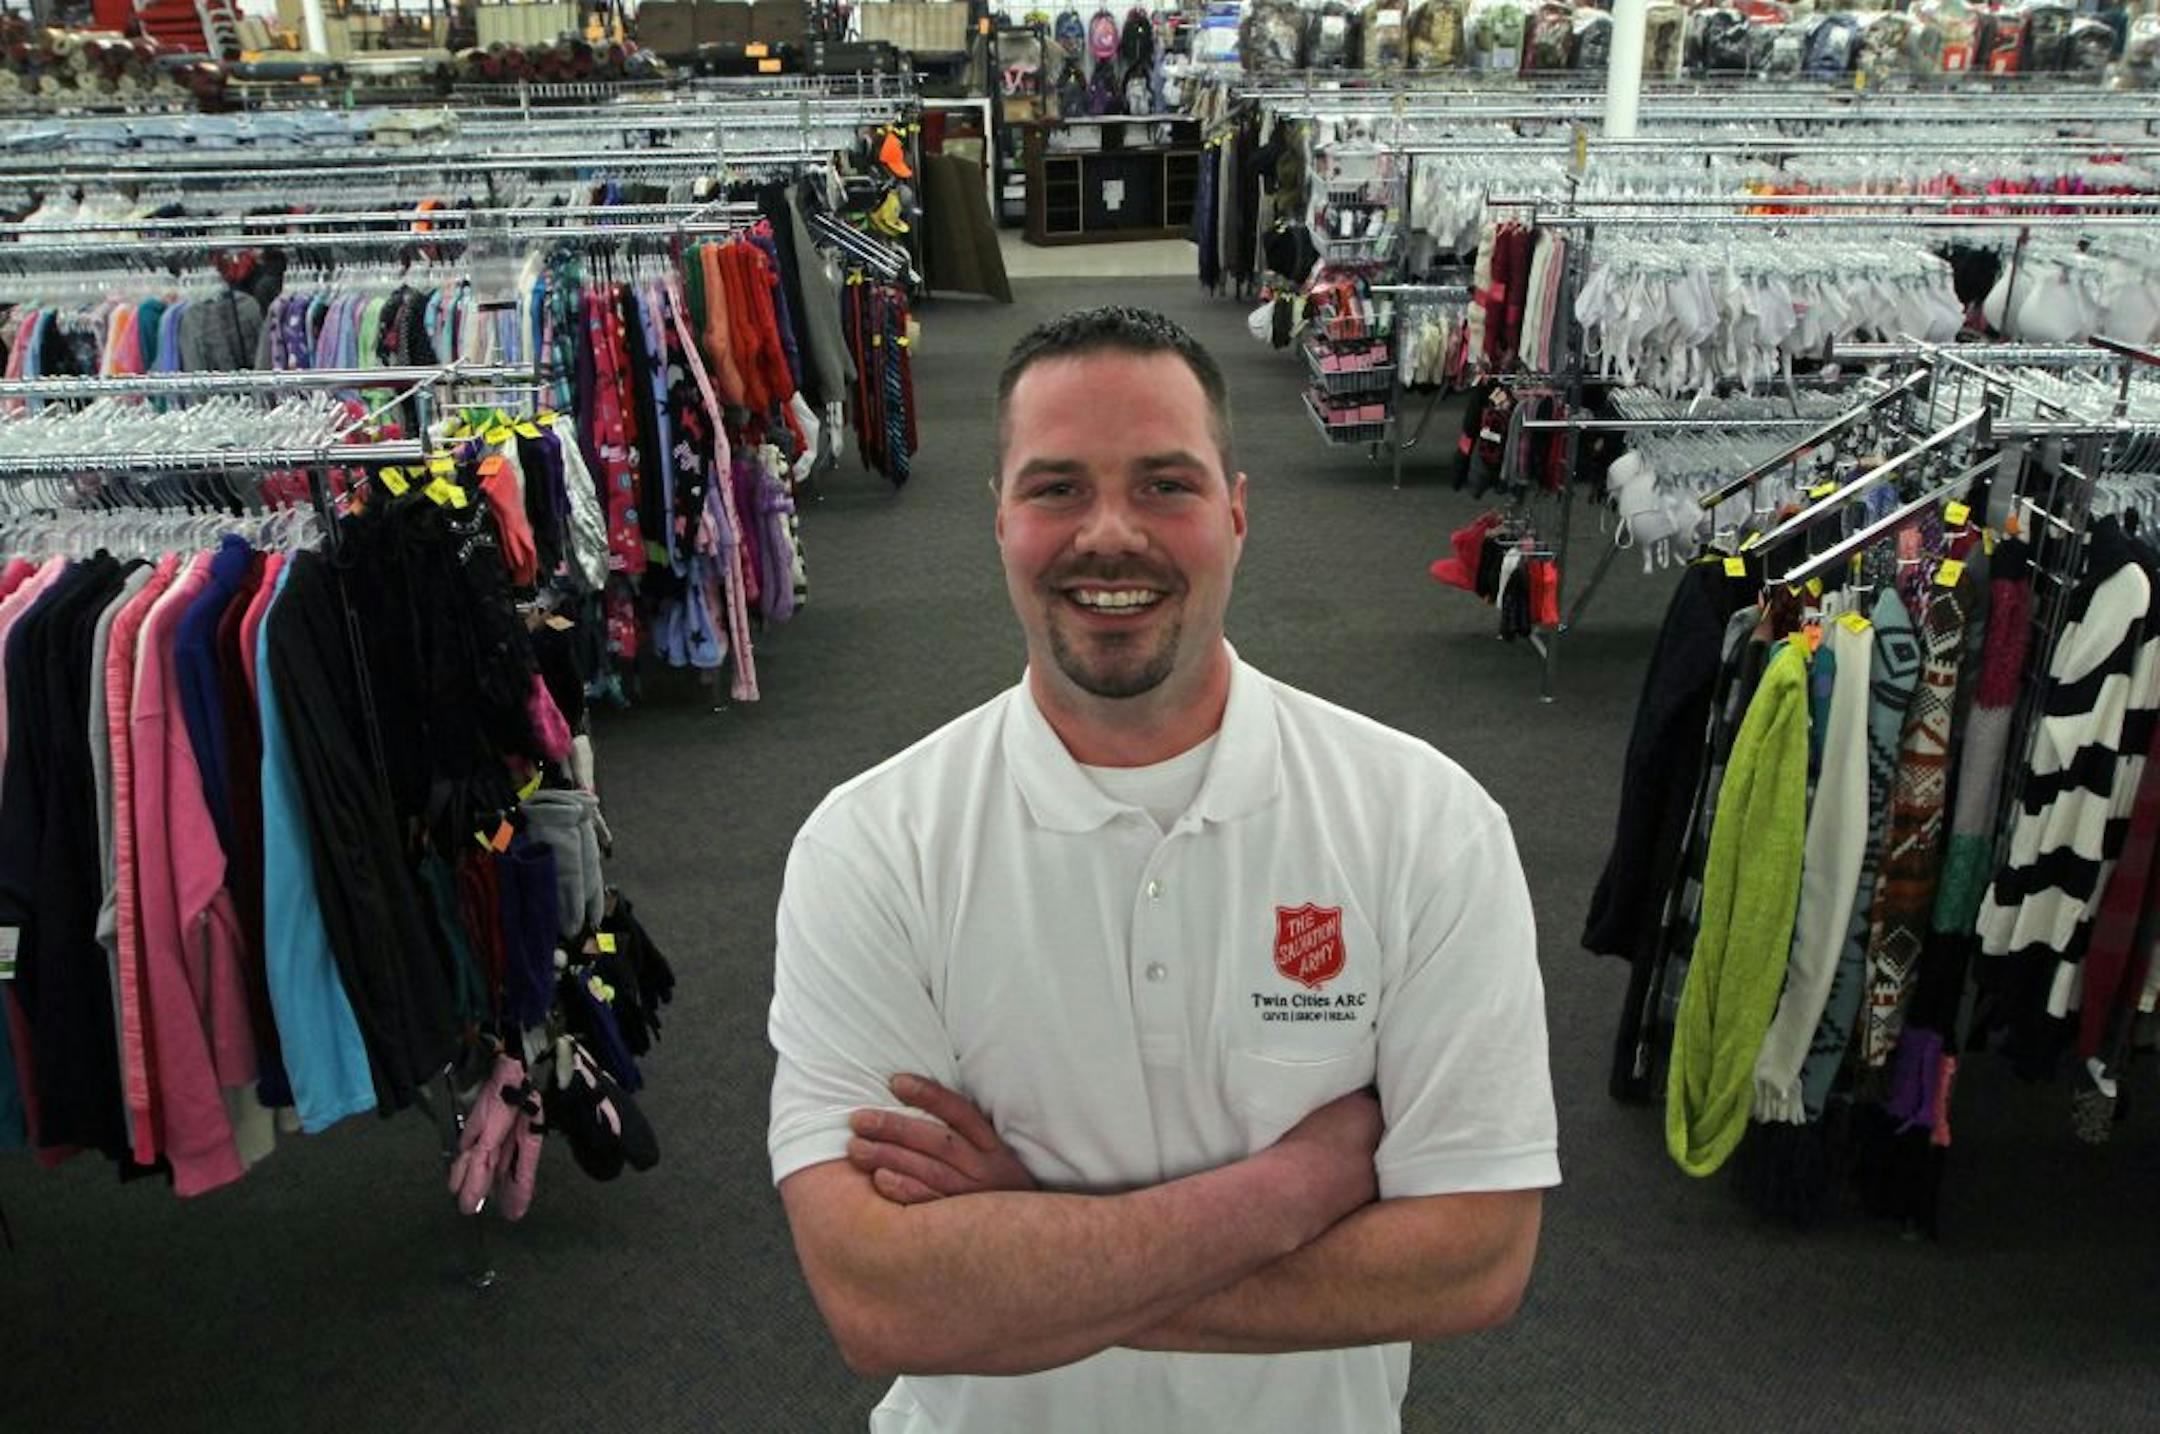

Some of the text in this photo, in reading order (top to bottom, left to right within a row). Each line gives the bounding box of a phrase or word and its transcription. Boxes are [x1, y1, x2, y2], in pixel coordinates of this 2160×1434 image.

[1288, 913, 1315, 938] THE
[1299, 941, 1334, 977] ARMY
[1251, 993, 1367, 1007] Twin Cities ARC
